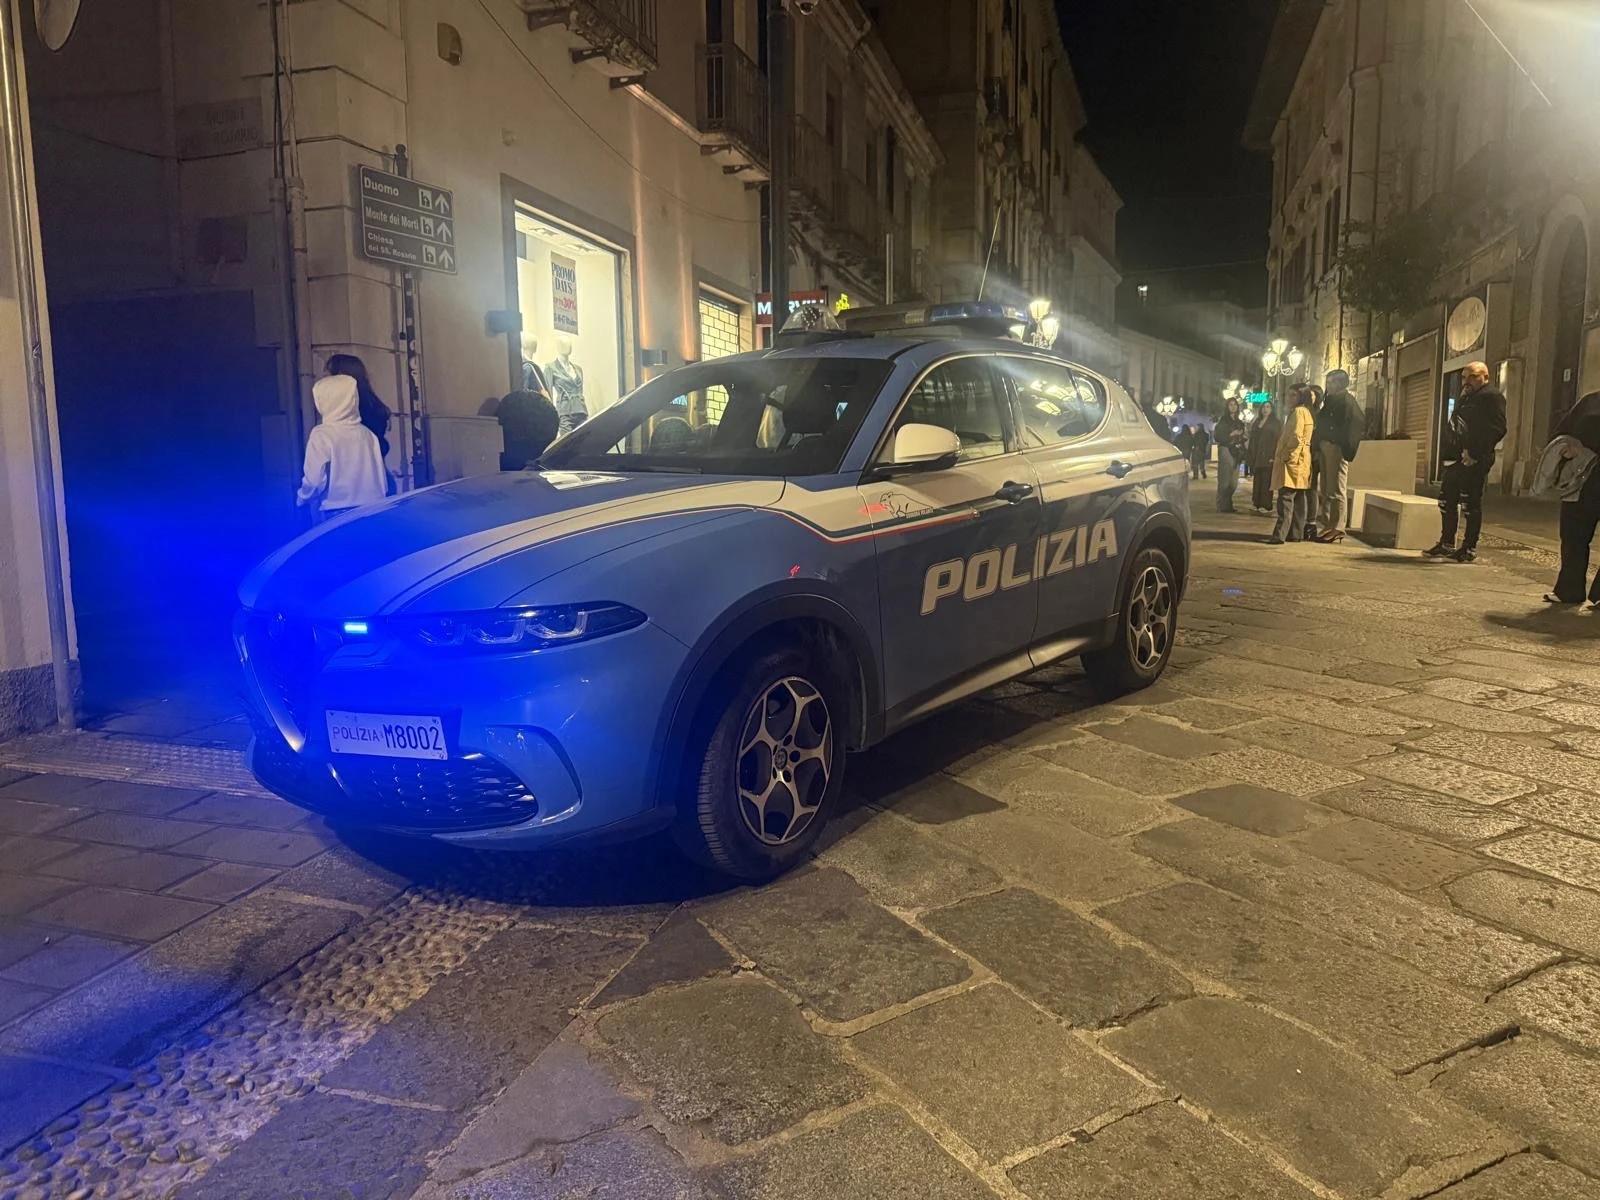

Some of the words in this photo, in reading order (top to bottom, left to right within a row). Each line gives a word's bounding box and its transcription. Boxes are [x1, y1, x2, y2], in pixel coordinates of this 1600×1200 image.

[364, 176, 399, 197] Duomo
[365, 206, 388, 222] Monte
[389, 213, 400, 225] dei
[402, 216, 419, 231] Morti
[368, 232, 394, 245] Chiesa
[552, 262, 576, 283] PROMO
[555, 277, 573, 295] DAYS
[919, 517, 1119, 617] POLIZIA
[332, 726, 380, 743] POLIZIA
[382, 723, 443, 751] M8002
